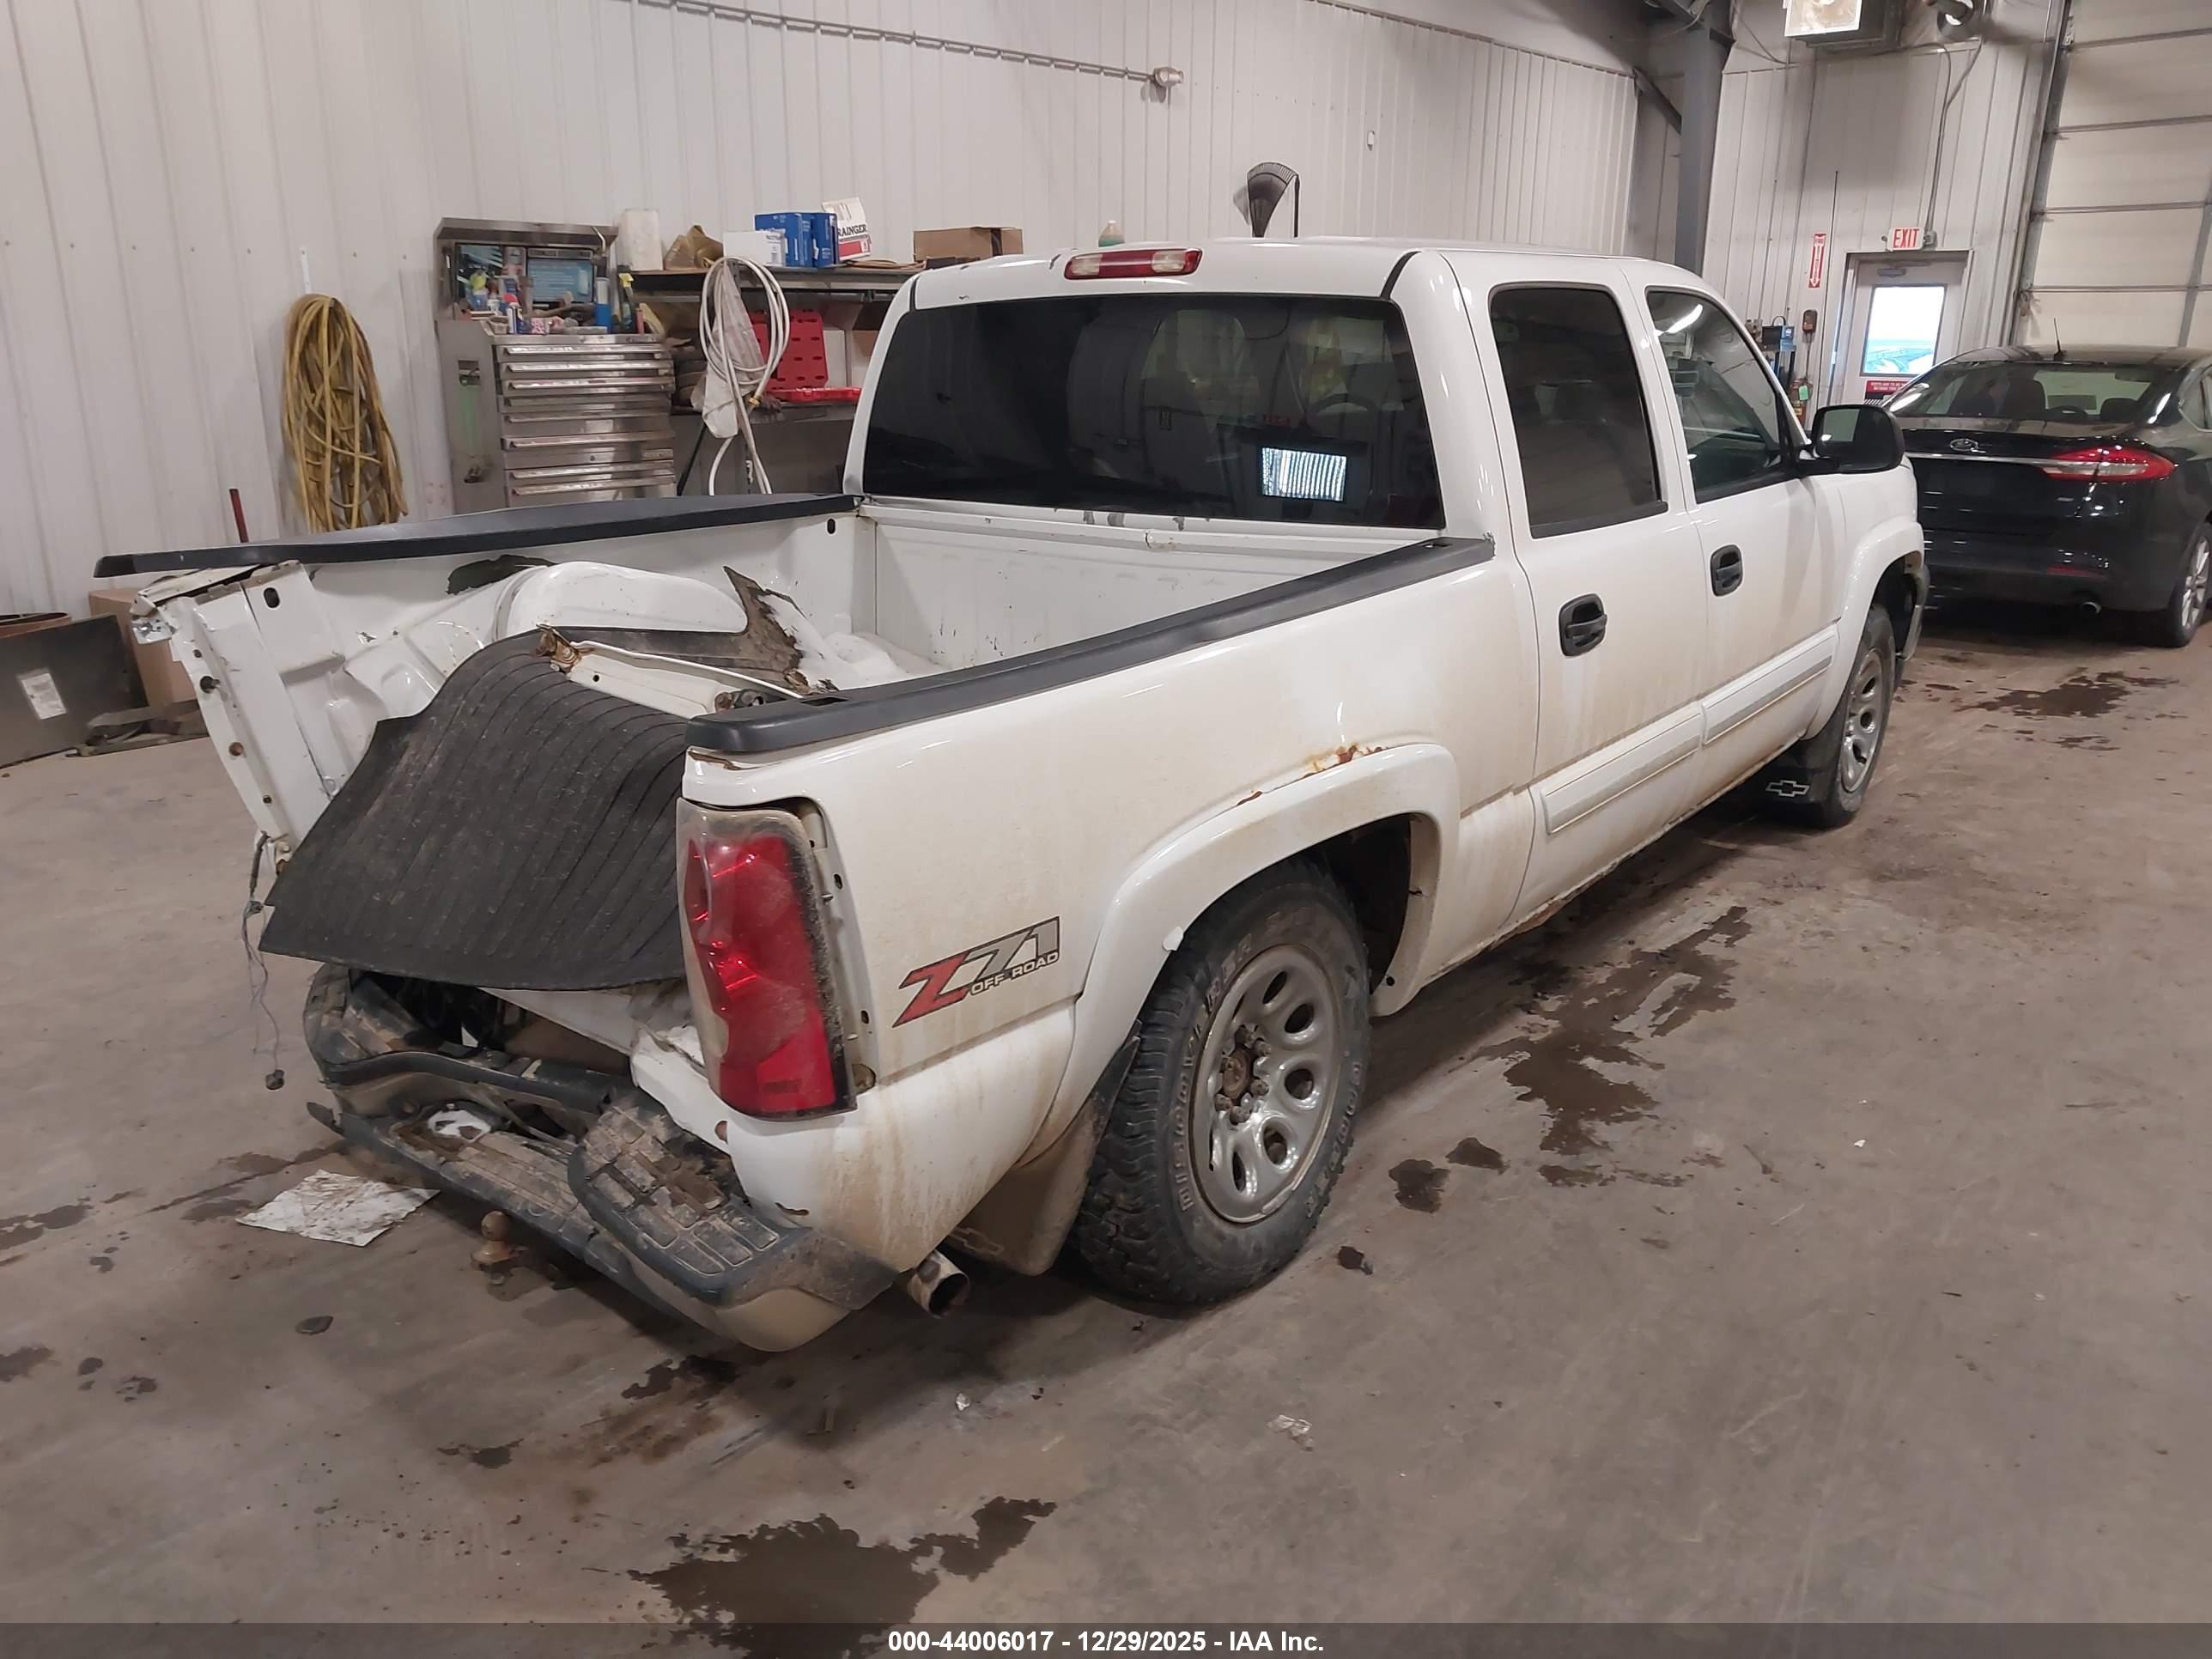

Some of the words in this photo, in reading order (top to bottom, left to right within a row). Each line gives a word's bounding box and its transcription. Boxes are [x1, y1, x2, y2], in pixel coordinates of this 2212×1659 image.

[837, 224, 867, 237] RAINGER
[1893, 228, 1920, 248] EXIT
[892, 916, 1060, 1028] Z71
[970, 973, 1008, 995] OFF
[1011, 952, 1060, 980] ROAD
